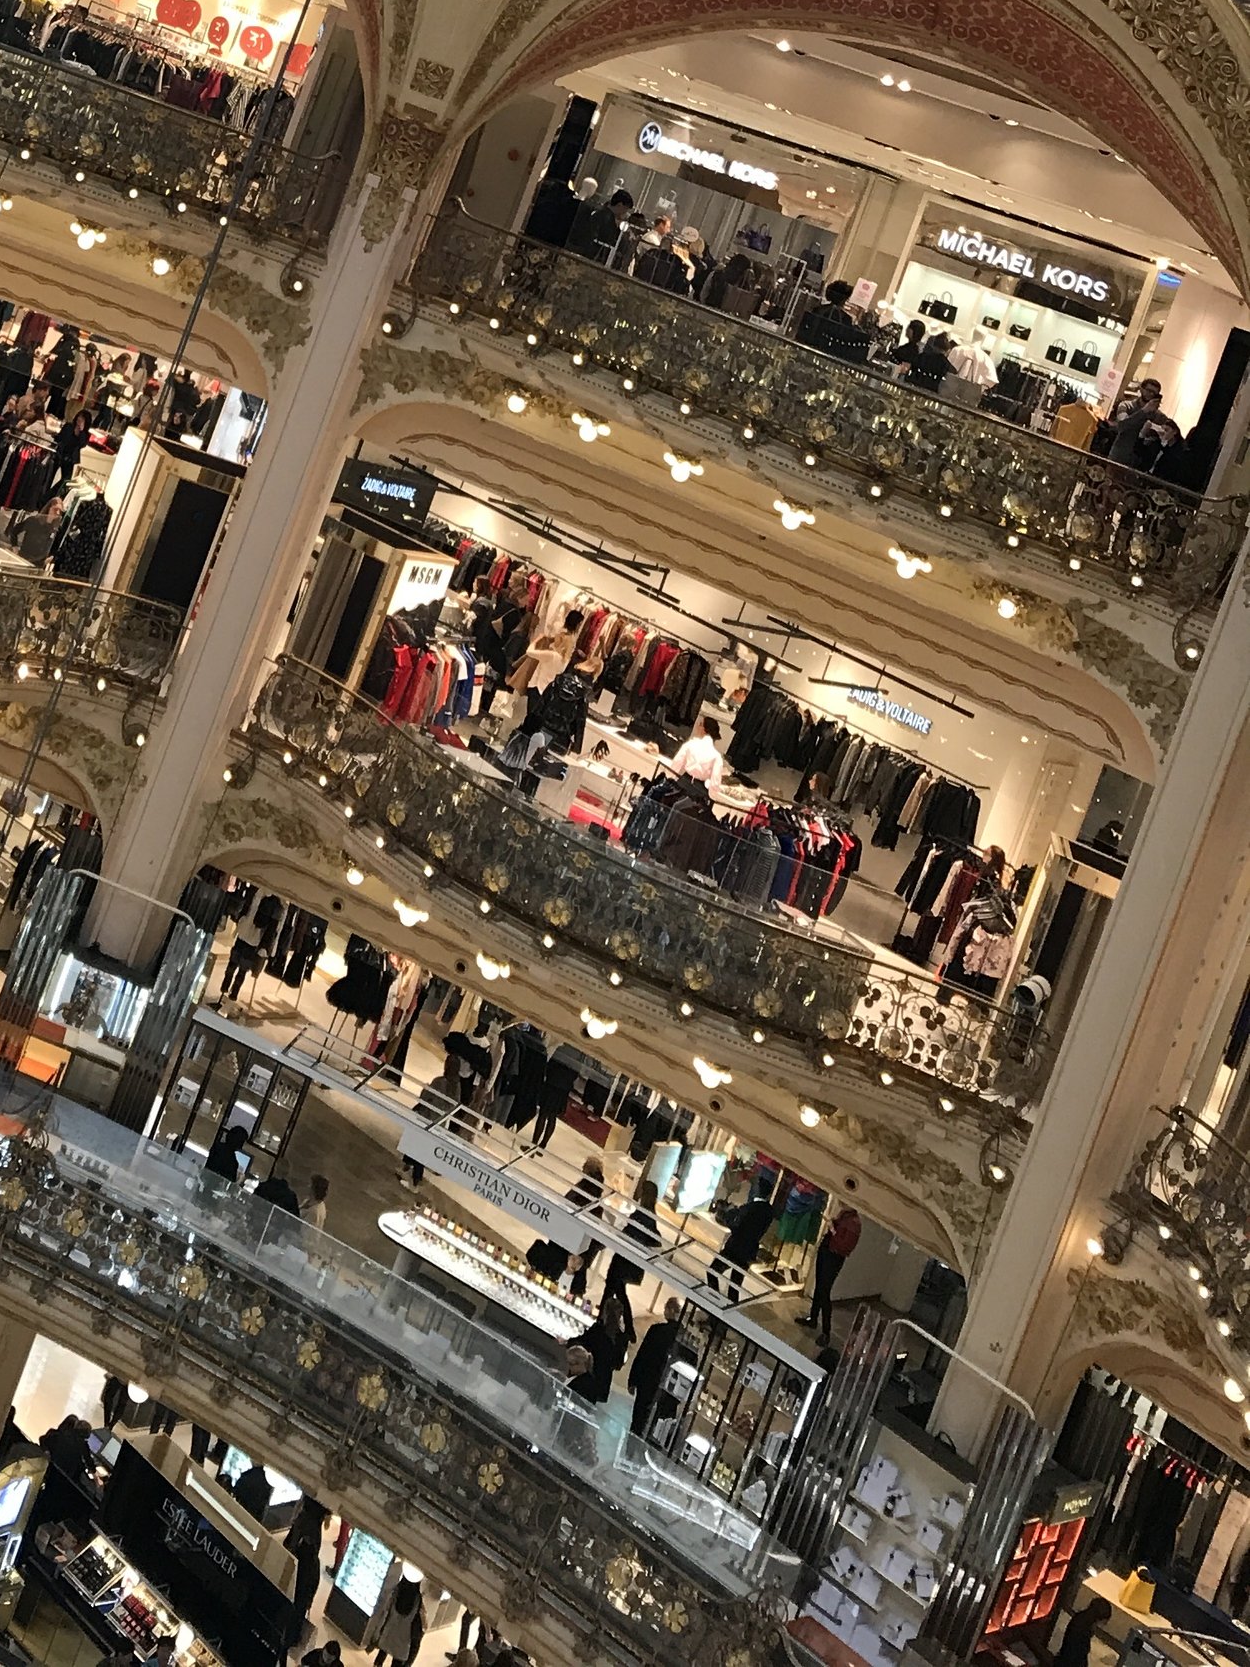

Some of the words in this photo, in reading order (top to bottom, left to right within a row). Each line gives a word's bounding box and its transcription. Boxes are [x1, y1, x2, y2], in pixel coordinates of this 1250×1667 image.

[937, 228, 1035, 279] MICHAEL
[1041, 264, 1110, 302] KORS
[408, 565, 443, 585] MSGM
[433, 1146, 512, 1198] CHRISTIAN
[512, 1191, 551, 1223] DIOR
[473, 1183, 504, 1207] PARIS
[193, 1528, 238, 1579] LAUDER
